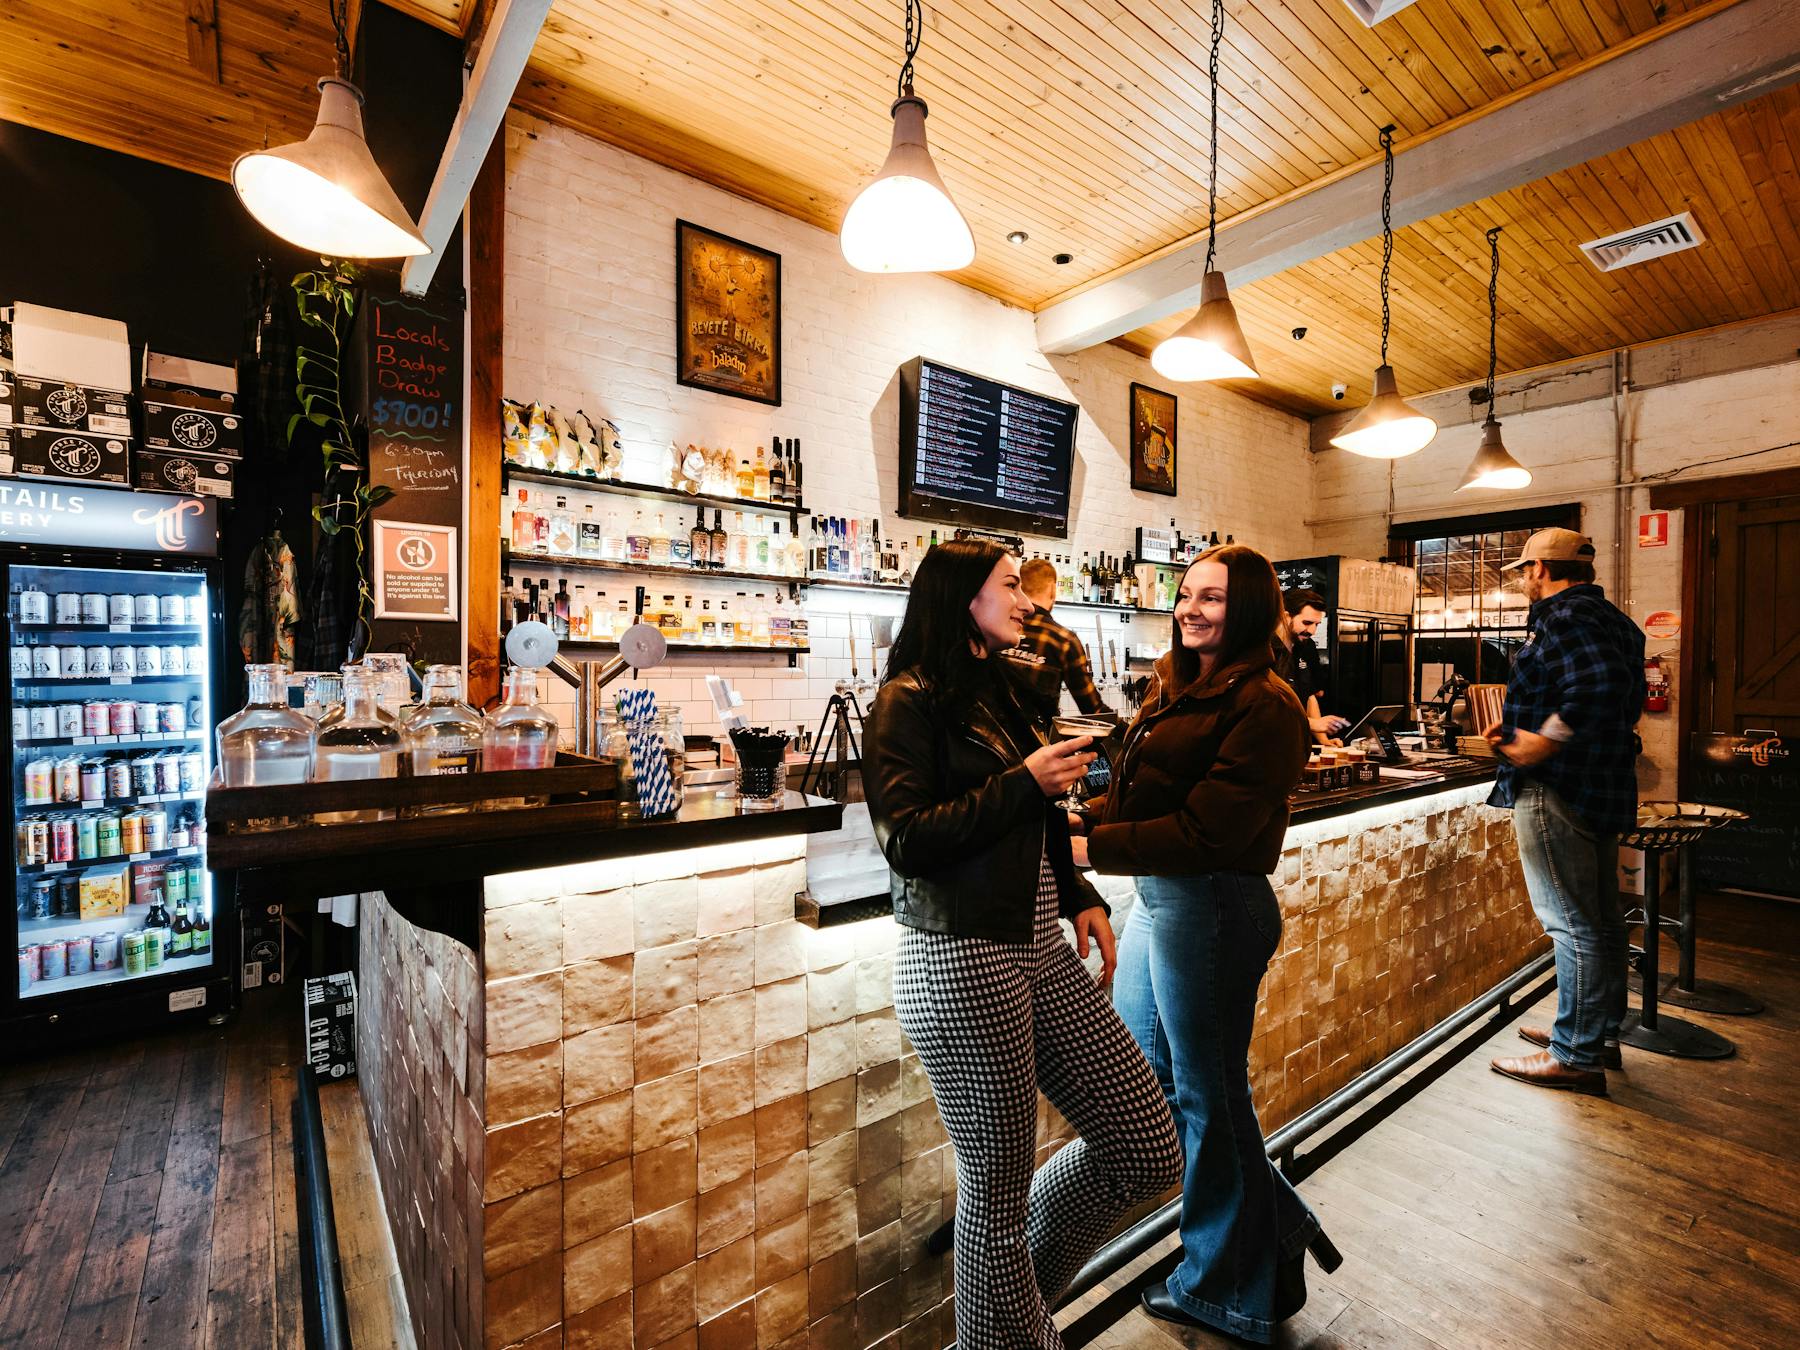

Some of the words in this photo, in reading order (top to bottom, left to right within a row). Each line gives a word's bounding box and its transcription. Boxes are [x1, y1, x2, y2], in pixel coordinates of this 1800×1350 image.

[375, 305, 450, 352] Locals
[376, 344, 447, 384] Badge
[378, 368, 441, 398] Draw
[0, 486, 84, 514] TAILS
